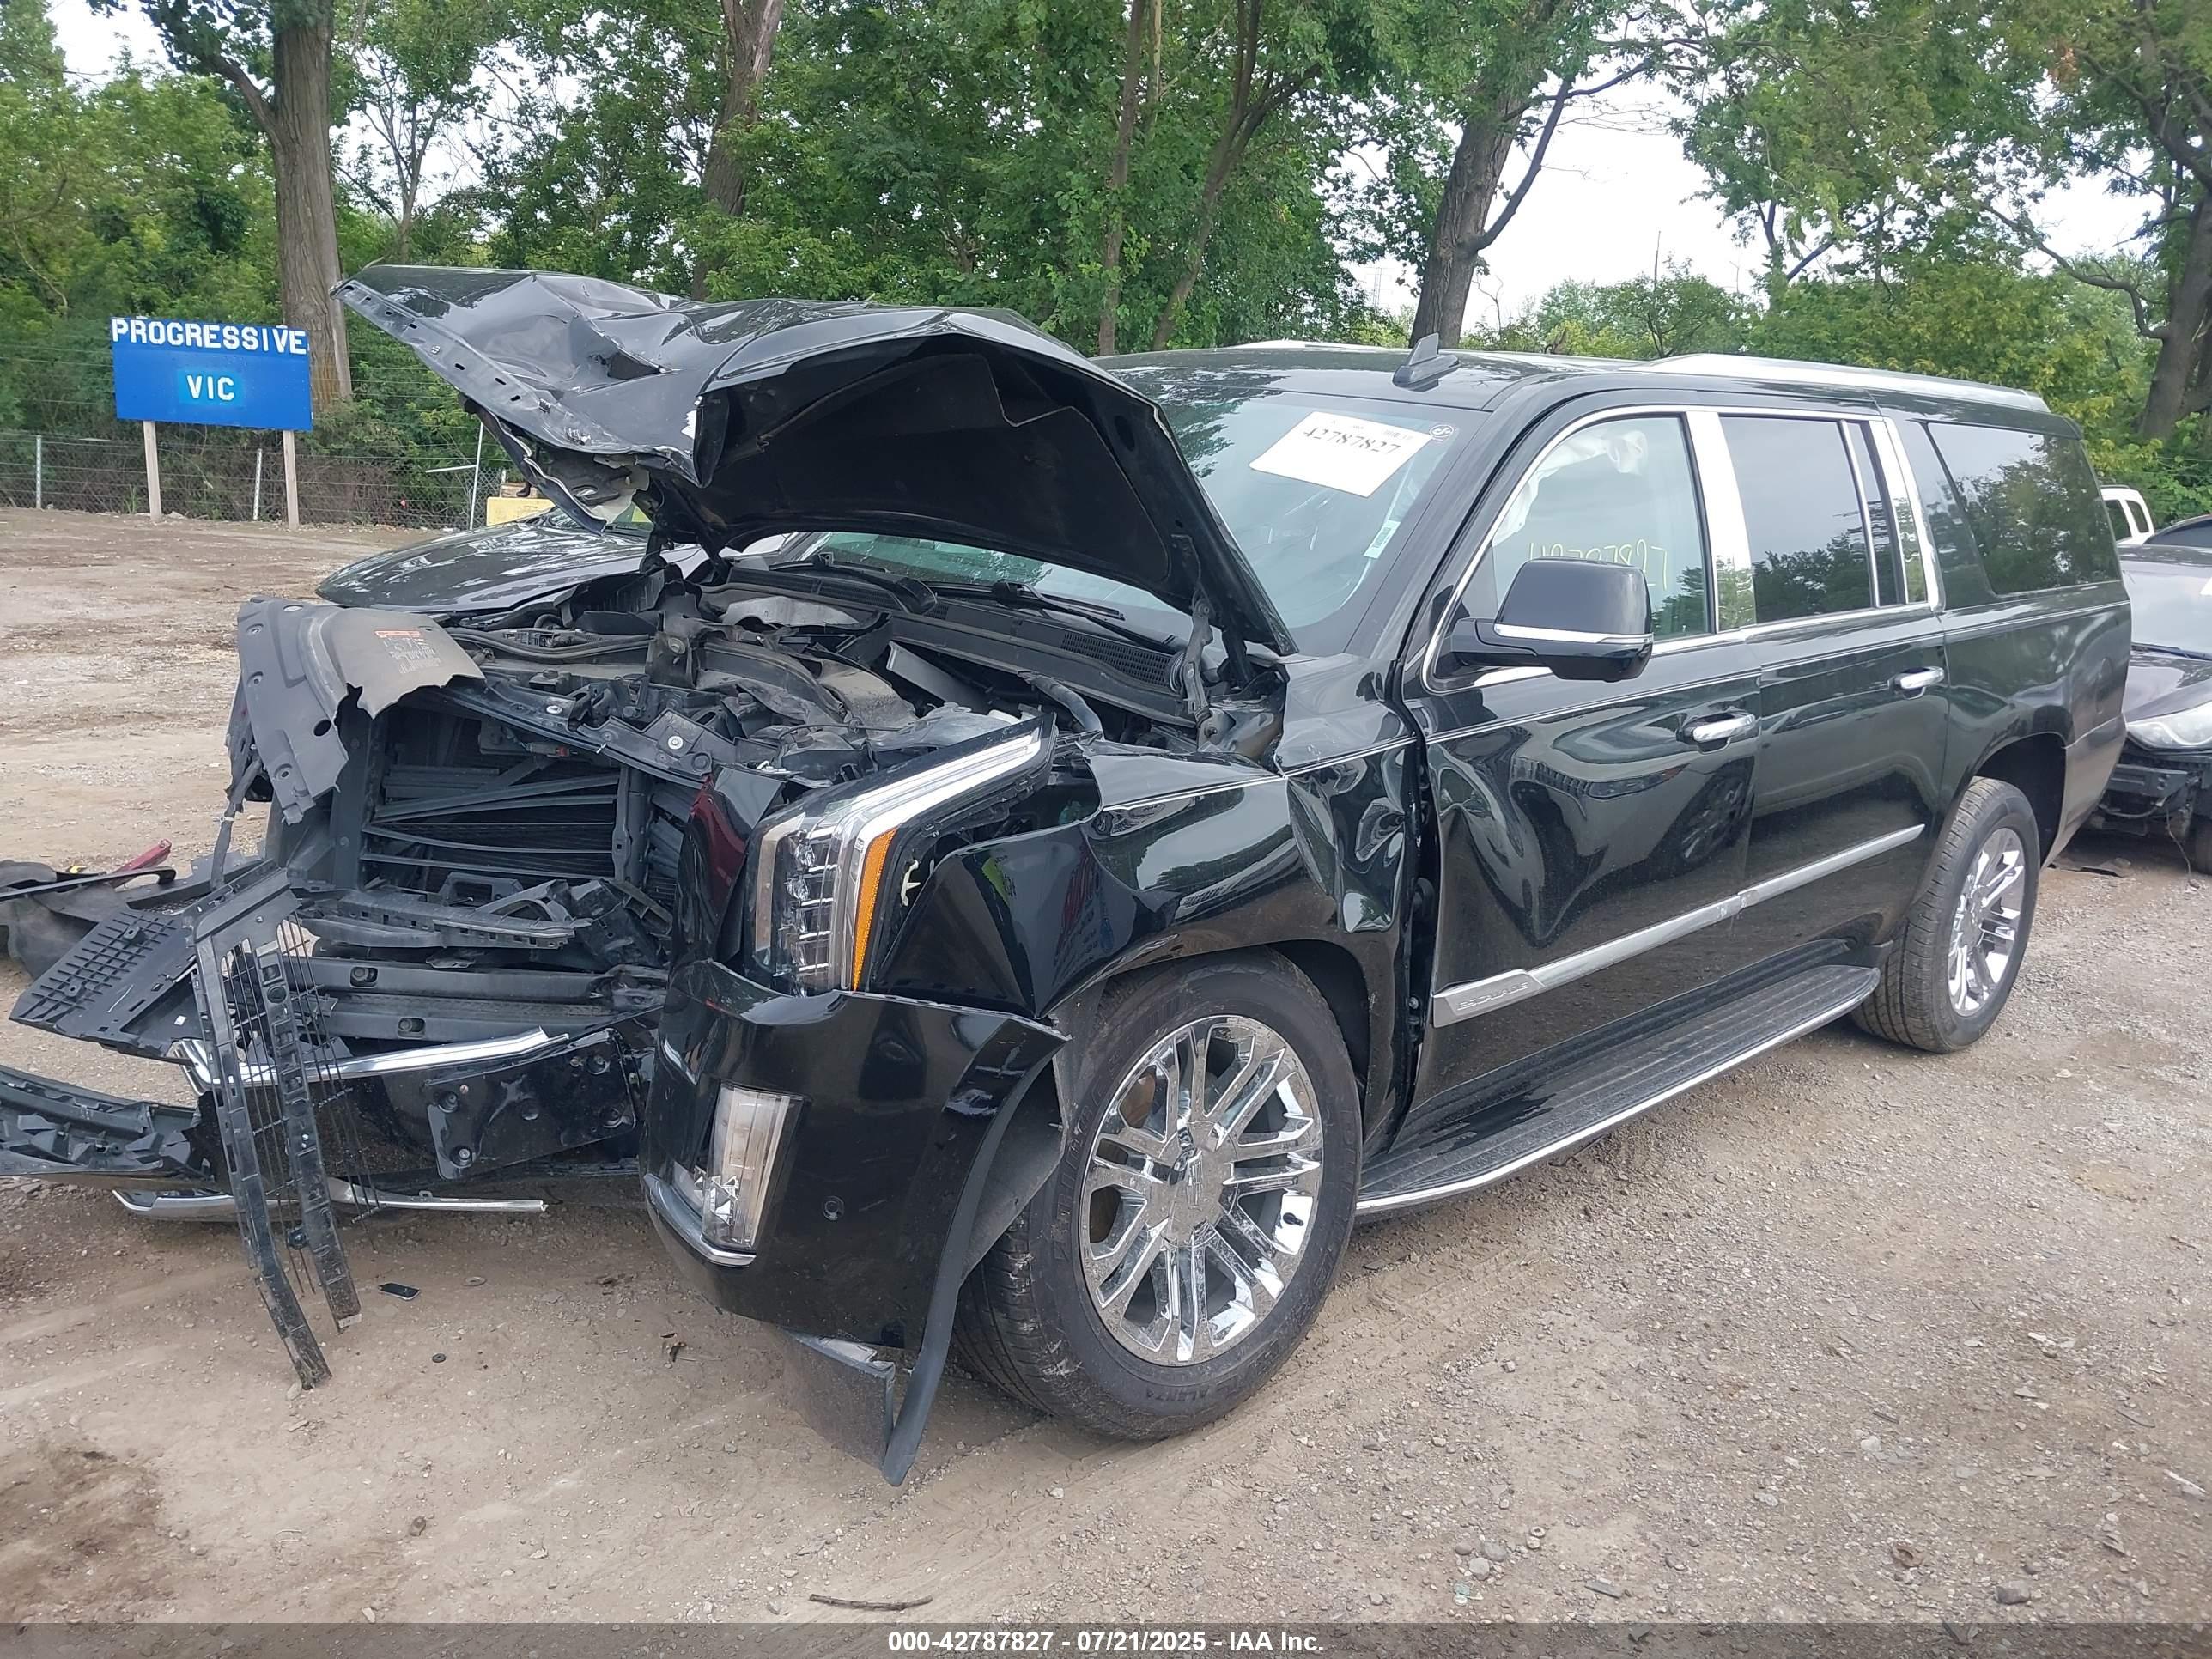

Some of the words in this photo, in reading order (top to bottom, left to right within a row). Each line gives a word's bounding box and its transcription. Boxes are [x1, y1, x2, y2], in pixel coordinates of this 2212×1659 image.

[112, 319, 307, 355] PROGRESSIVE
[186, 375, 235, 401] VIC
[1302, 427, 1401, 454] 42787827
